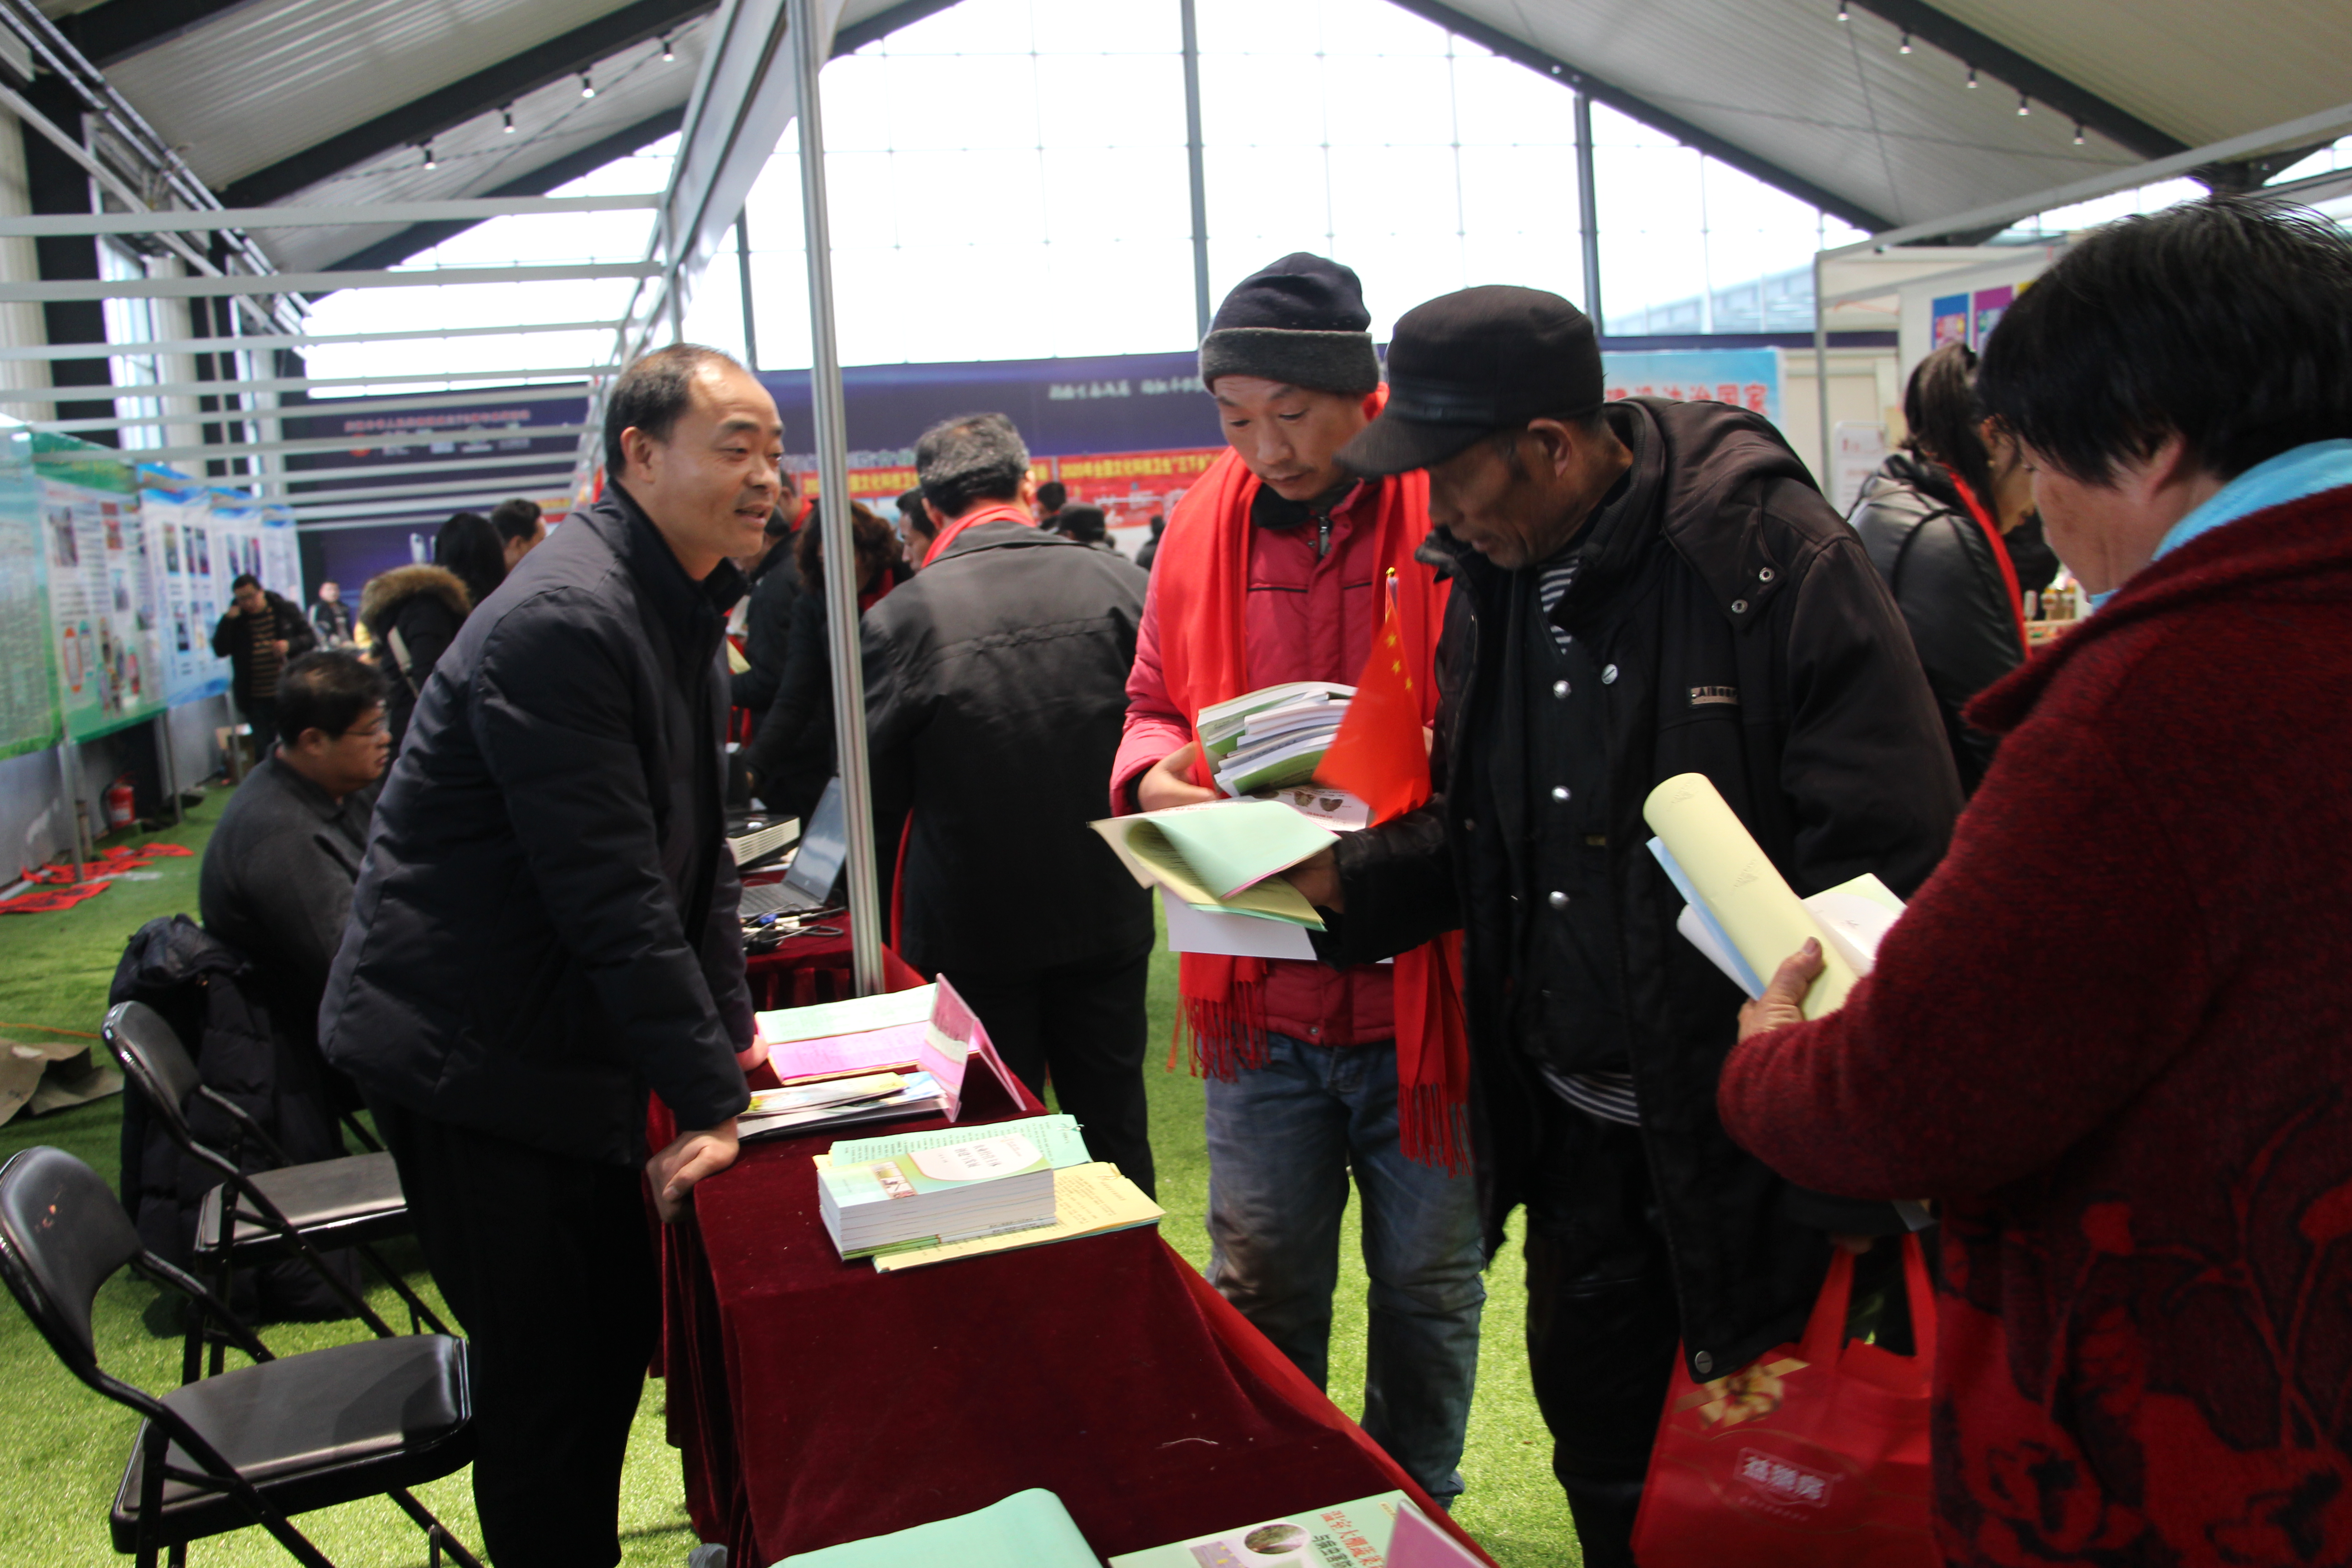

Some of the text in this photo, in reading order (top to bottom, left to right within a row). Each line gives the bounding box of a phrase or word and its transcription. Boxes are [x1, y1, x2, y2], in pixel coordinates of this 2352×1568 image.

[1312, 1534, 1355, 1568] 与病虫害防
[1320, 1510, 1385, 1568] 温室大棚蔬菜
